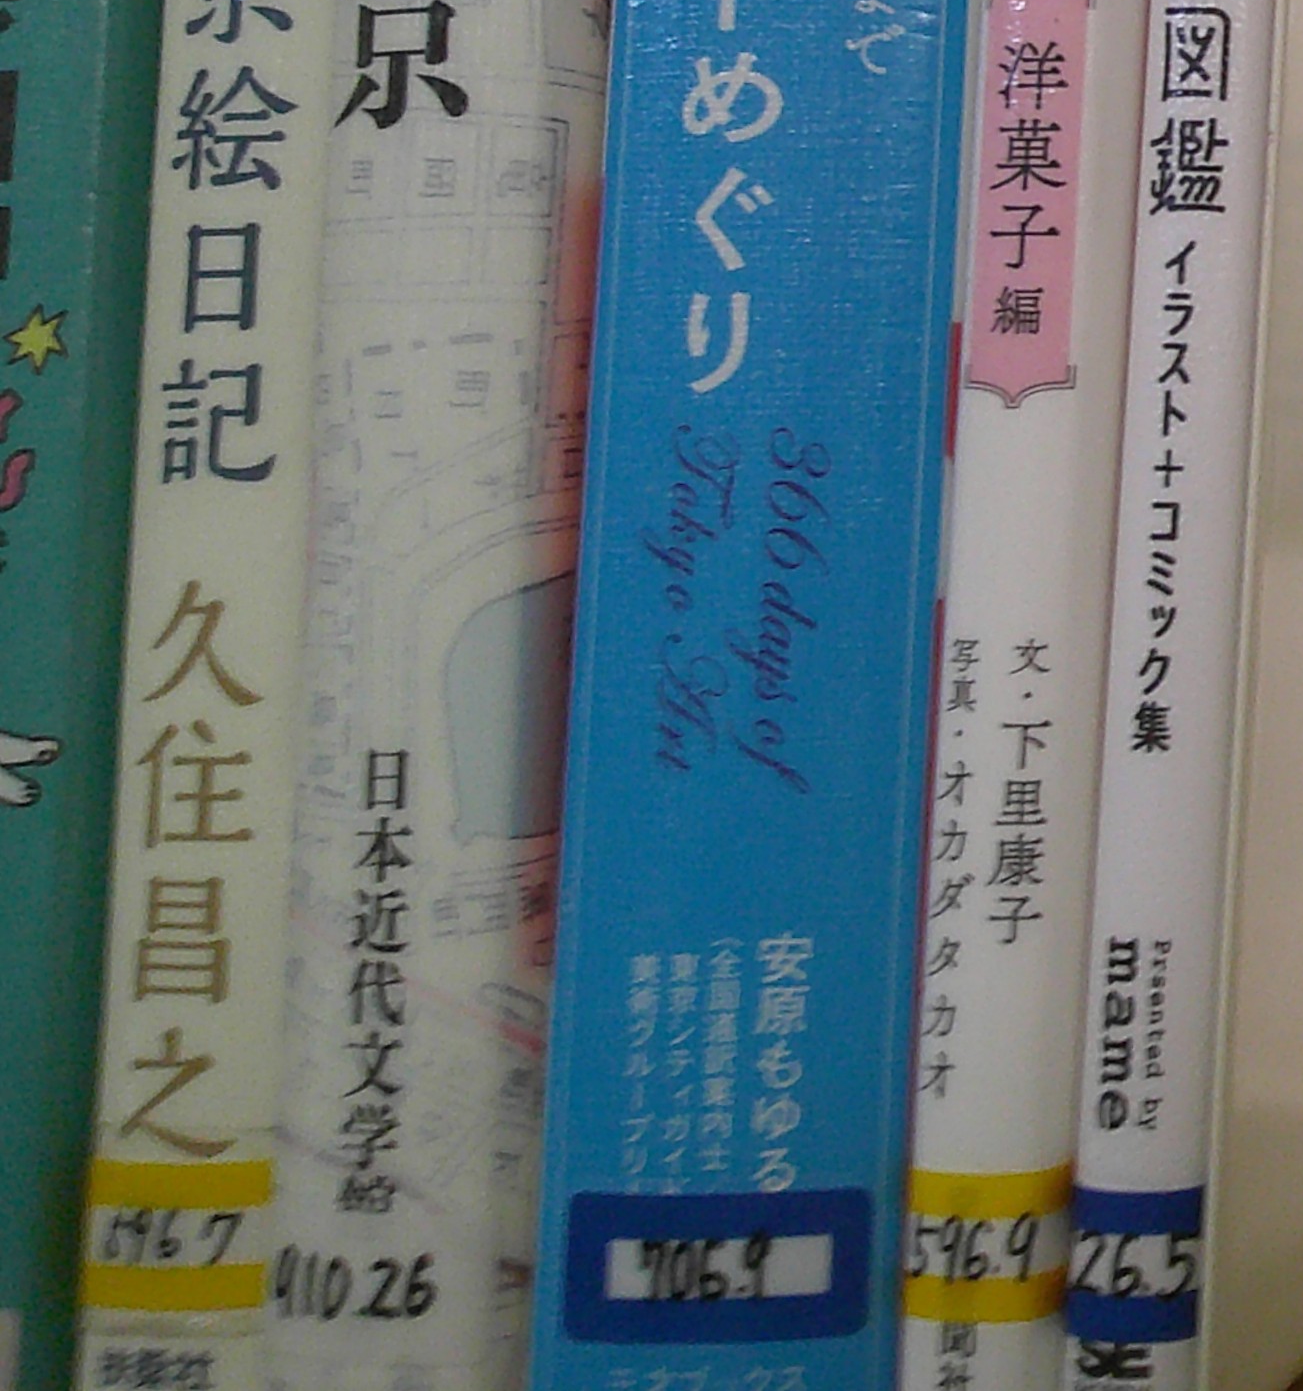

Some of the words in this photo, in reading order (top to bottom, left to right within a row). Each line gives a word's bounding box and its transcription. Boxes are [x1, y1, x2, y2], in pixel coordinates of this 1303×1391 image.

[988, 40, 1070, 337] 洋菓子編
[641, 424, 742, 609] Tokyo
[762, 425, 832, 574] 366
[727, 580, 818, 704] days
[120, 579, 264, 1159] 久住昌之
[735, 717, 812, 799] of
[917, 637, 981, 1099] 写真・オカダタカオ
[984, 638, 1052, 945] 文・下里康子
[336, 747, 413, 1214] 日本近代文学館
[749, 931, 816, 1194] 安原もゆる
[1099, 936, 1140, 1134] mame
[1137, 1097, 1163, 1134] by
